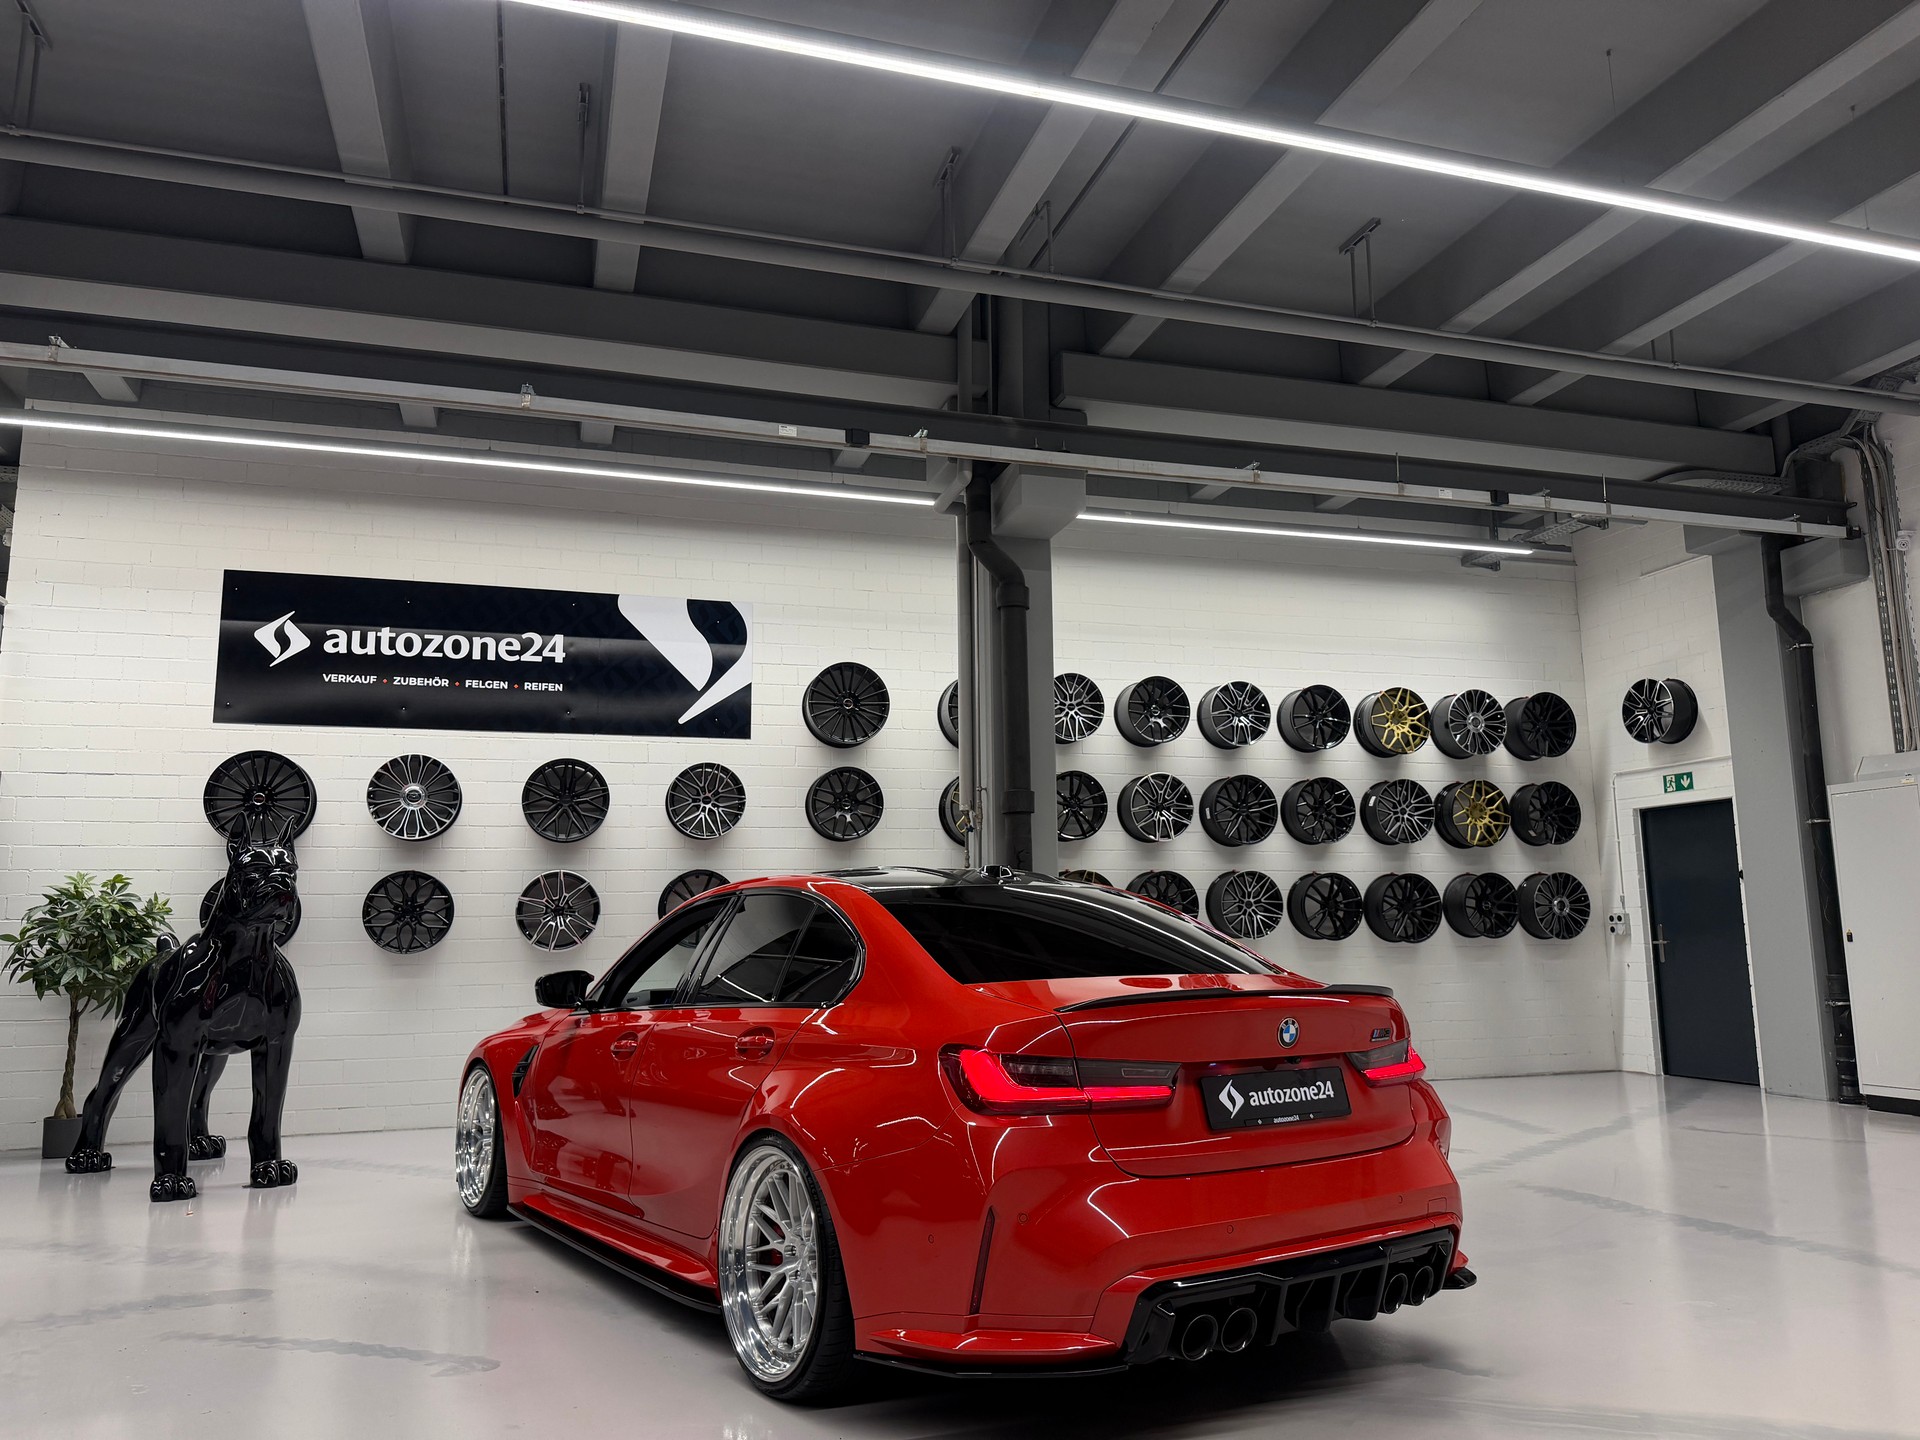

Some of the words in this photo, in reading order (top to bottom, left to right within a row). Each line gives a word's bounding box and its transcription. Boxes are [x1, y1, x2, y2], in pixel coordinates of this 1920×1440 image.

[323, 626, 566, 663] autozone24
[322, 673, 378, 685] VERKAUF
[392, 676, 450, 688] ZUBEHÖR
[465, 679, 509, 690] FELGEN
[524, 681, 564, 692] REIFEN
[1248, 1080, 1335, 1107] autozone24
[1273, 1114, 1300, 1124] autozone24
